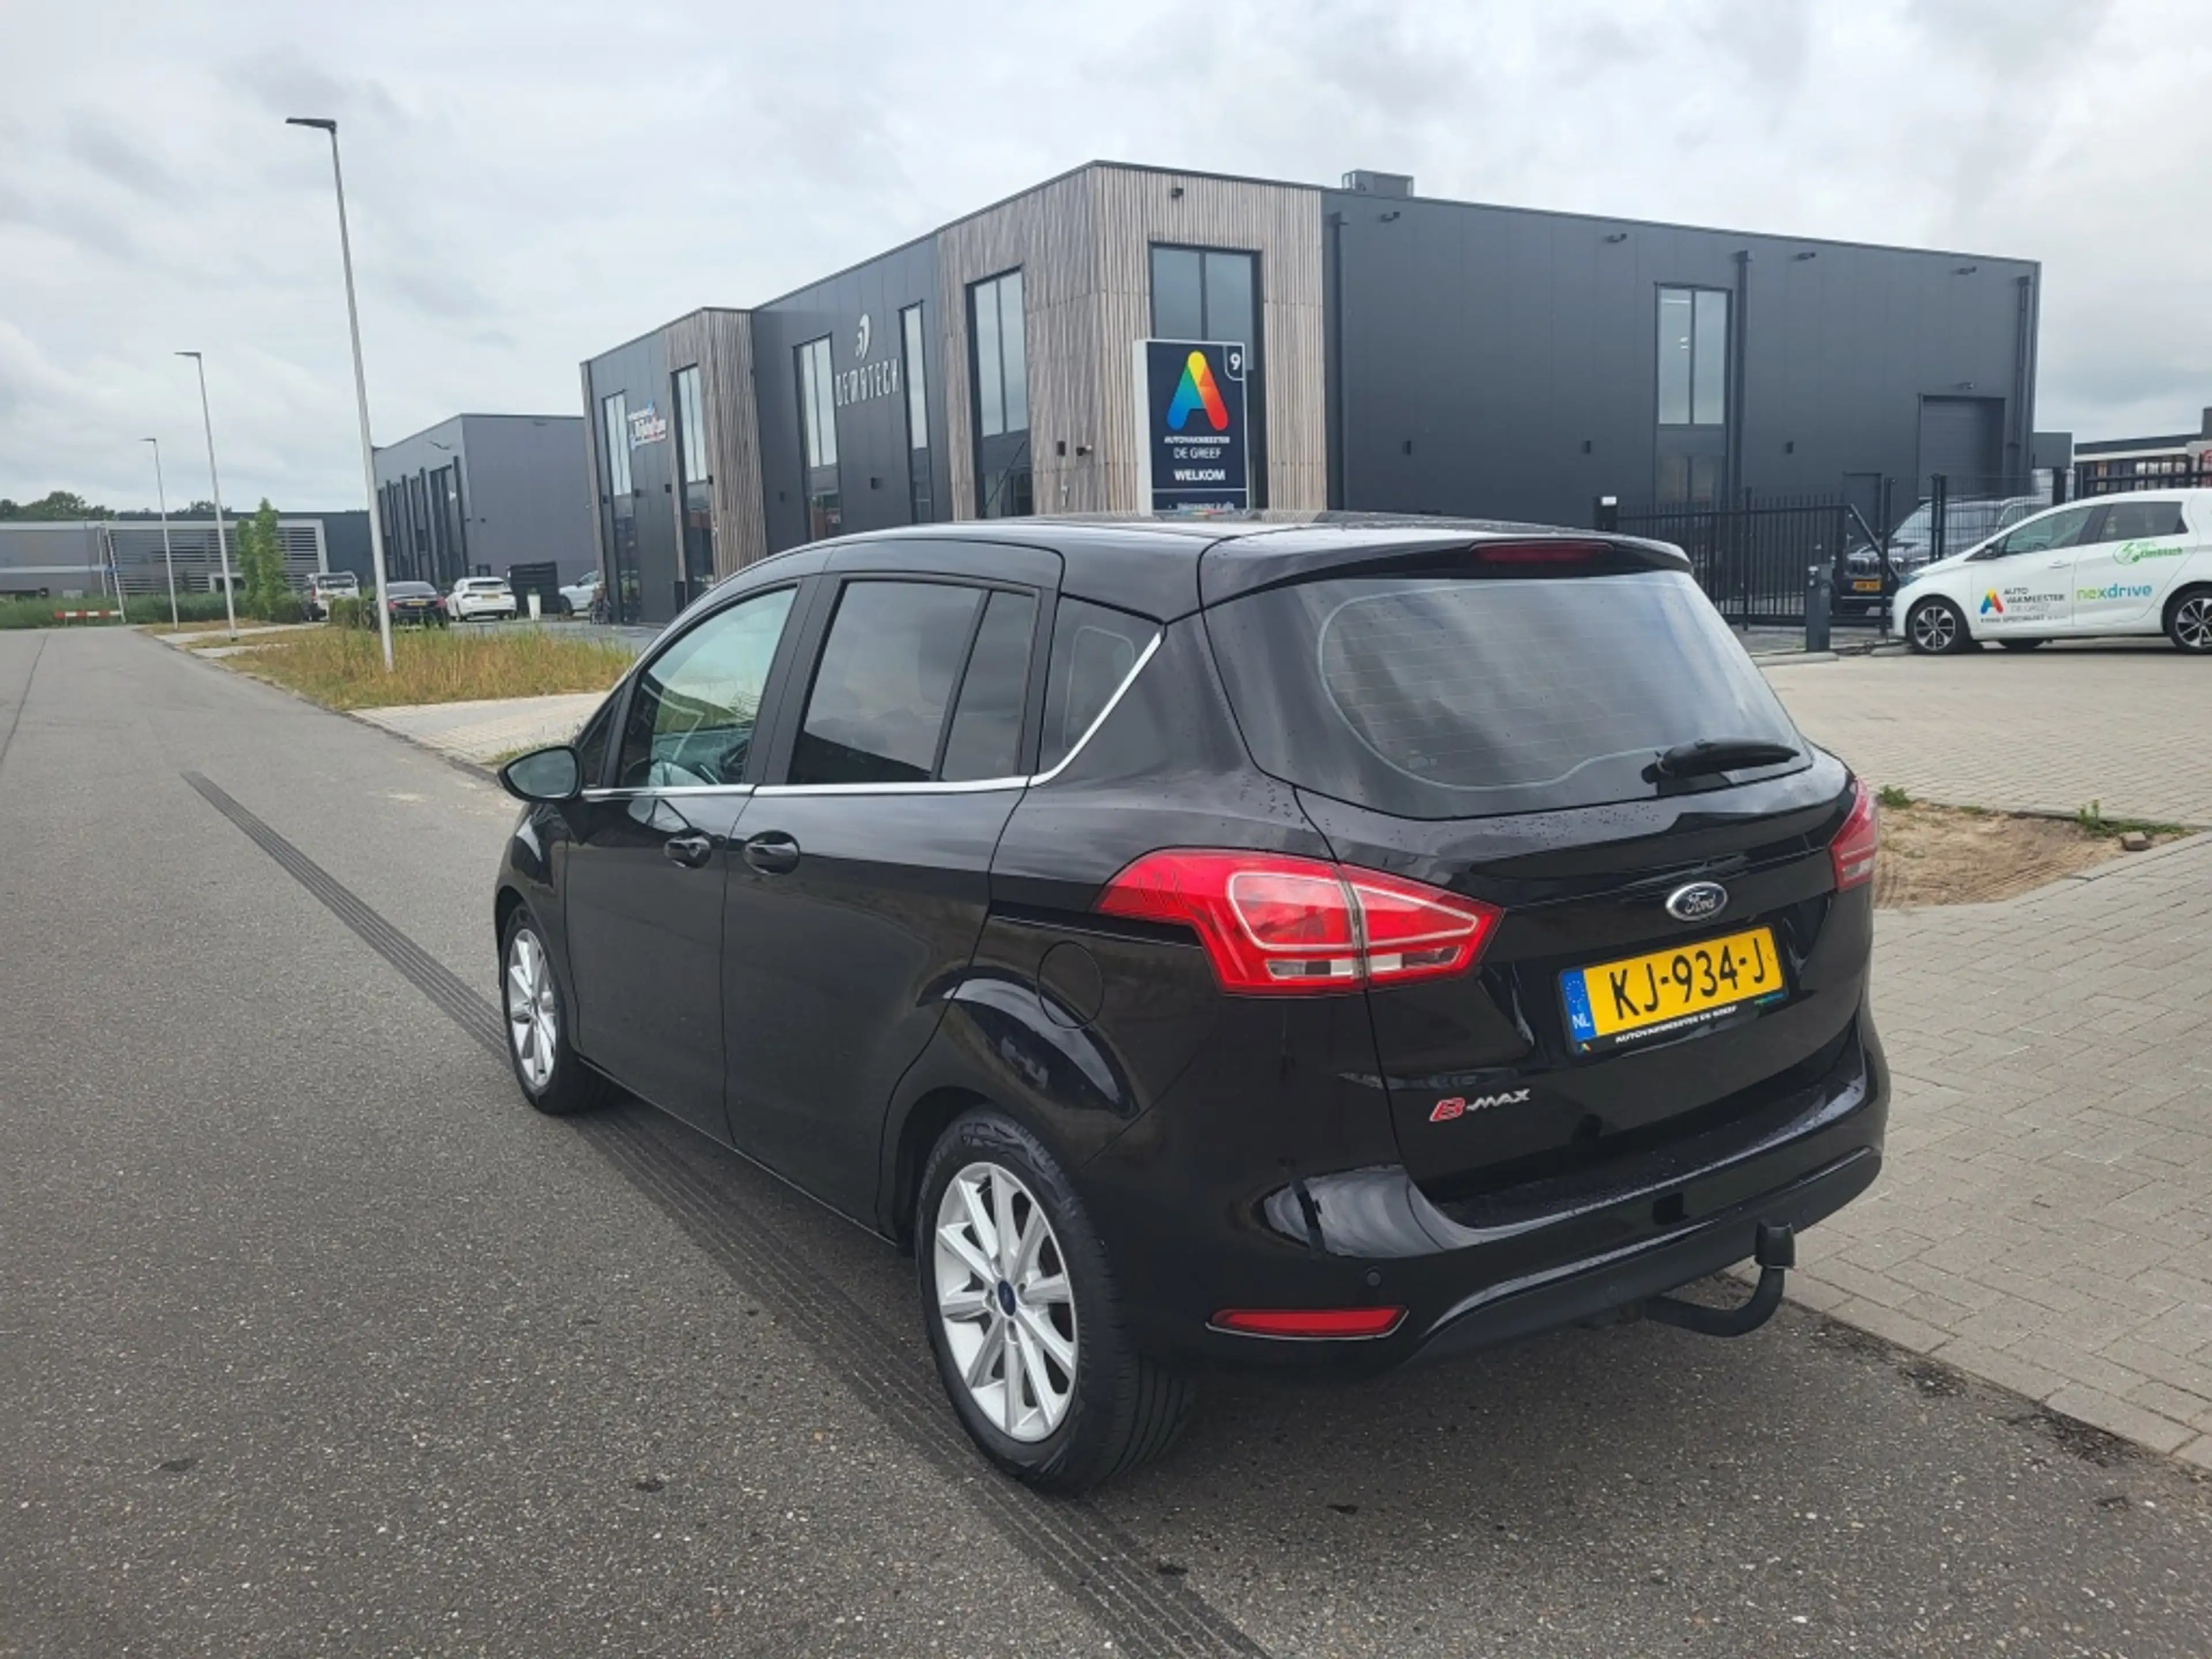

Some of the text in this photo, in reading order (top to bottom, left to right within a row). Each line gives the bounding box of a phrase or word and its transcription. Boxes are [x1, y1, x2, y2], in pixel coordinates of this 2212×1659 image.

[1229, 352, 1241, 370] 9
[1173, 447, 1188, 459] DE
[1173, 468, 1226, 481] WELKOM
[2076, 583, 2152, 600] nexdrive
[1609, 937, 1764, 1020] KJ-934-J
[1572, 1013, 1590, 1030] NL
